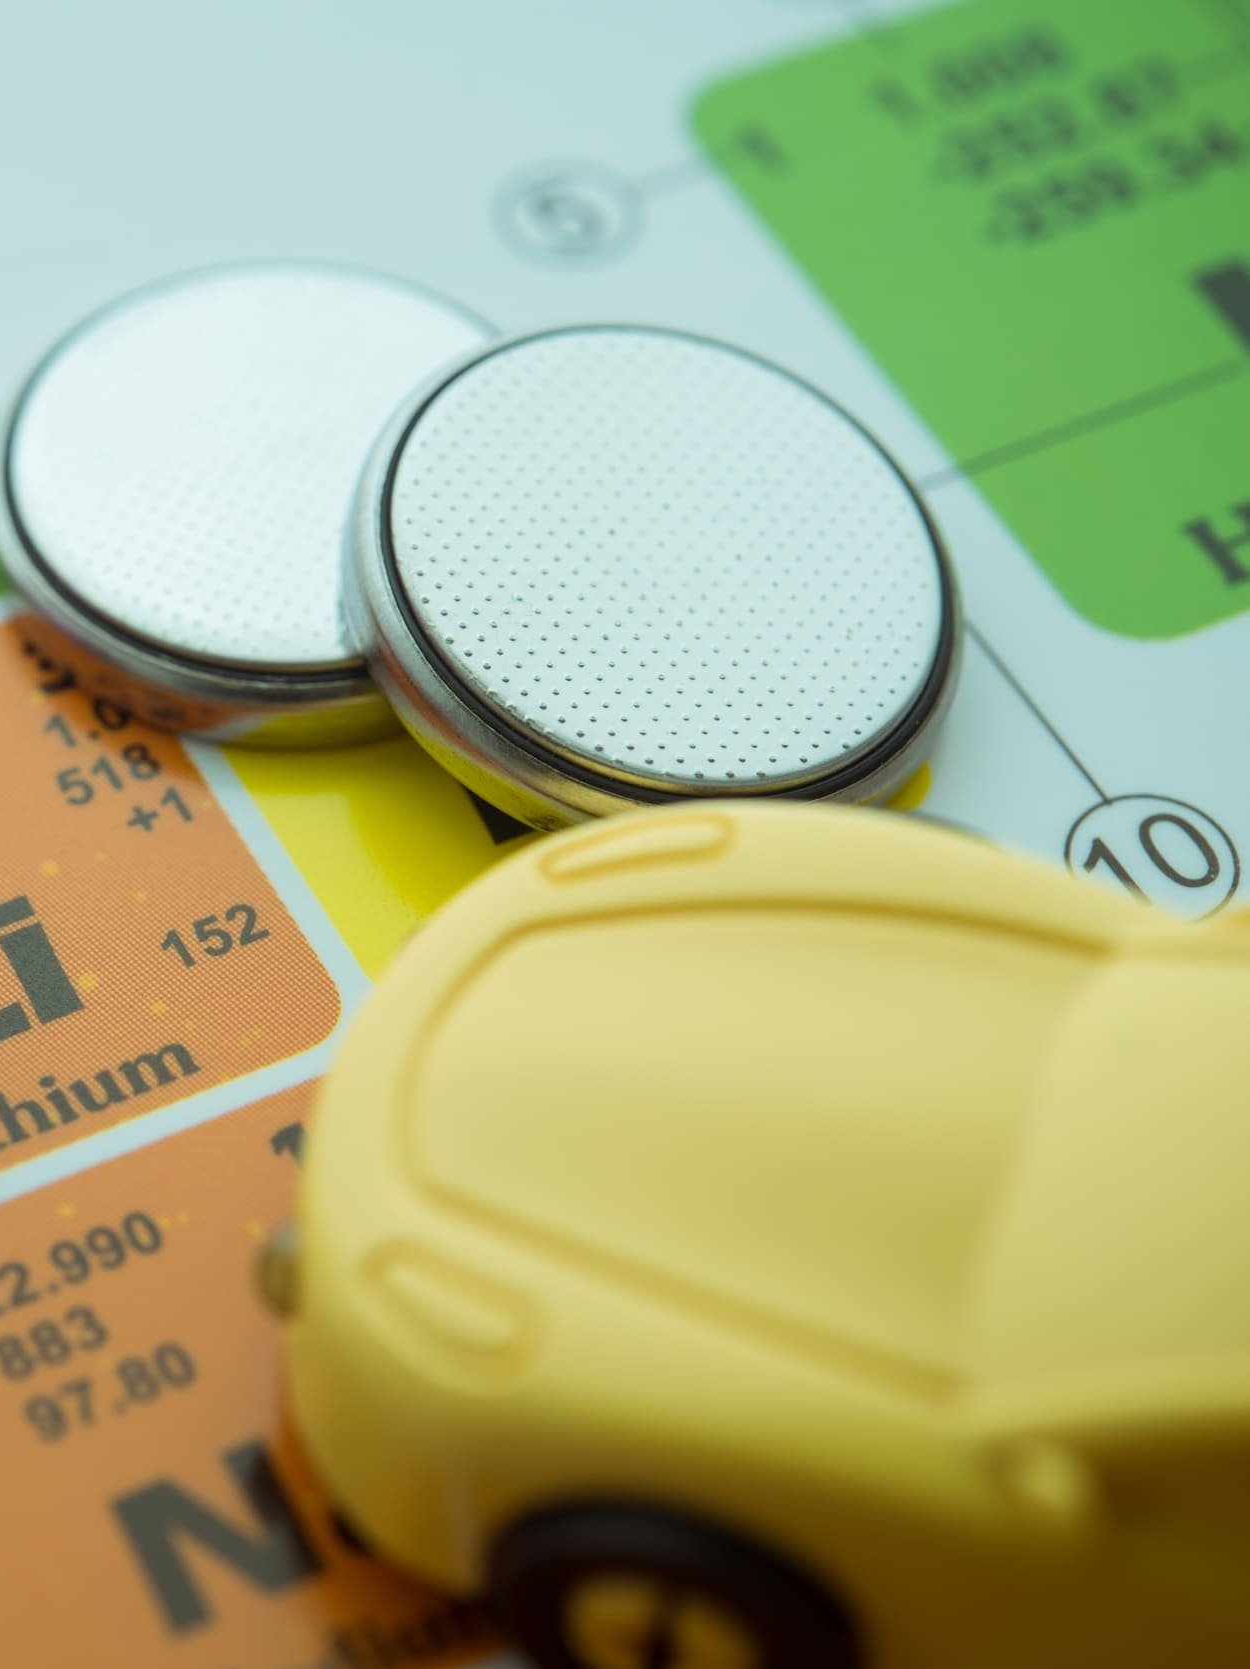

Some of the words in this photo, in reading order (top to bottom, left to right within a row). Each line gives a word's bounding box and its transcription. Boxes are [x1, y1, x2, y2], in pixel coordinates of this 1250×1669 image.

[57, 742, 162, 807] 518
[127, 786, 194, 832] +1
[1083, 812, 1221, 904] 10
[160, 903, 271, 970] 152
[22, 1341, 198, 1444] 97.80
